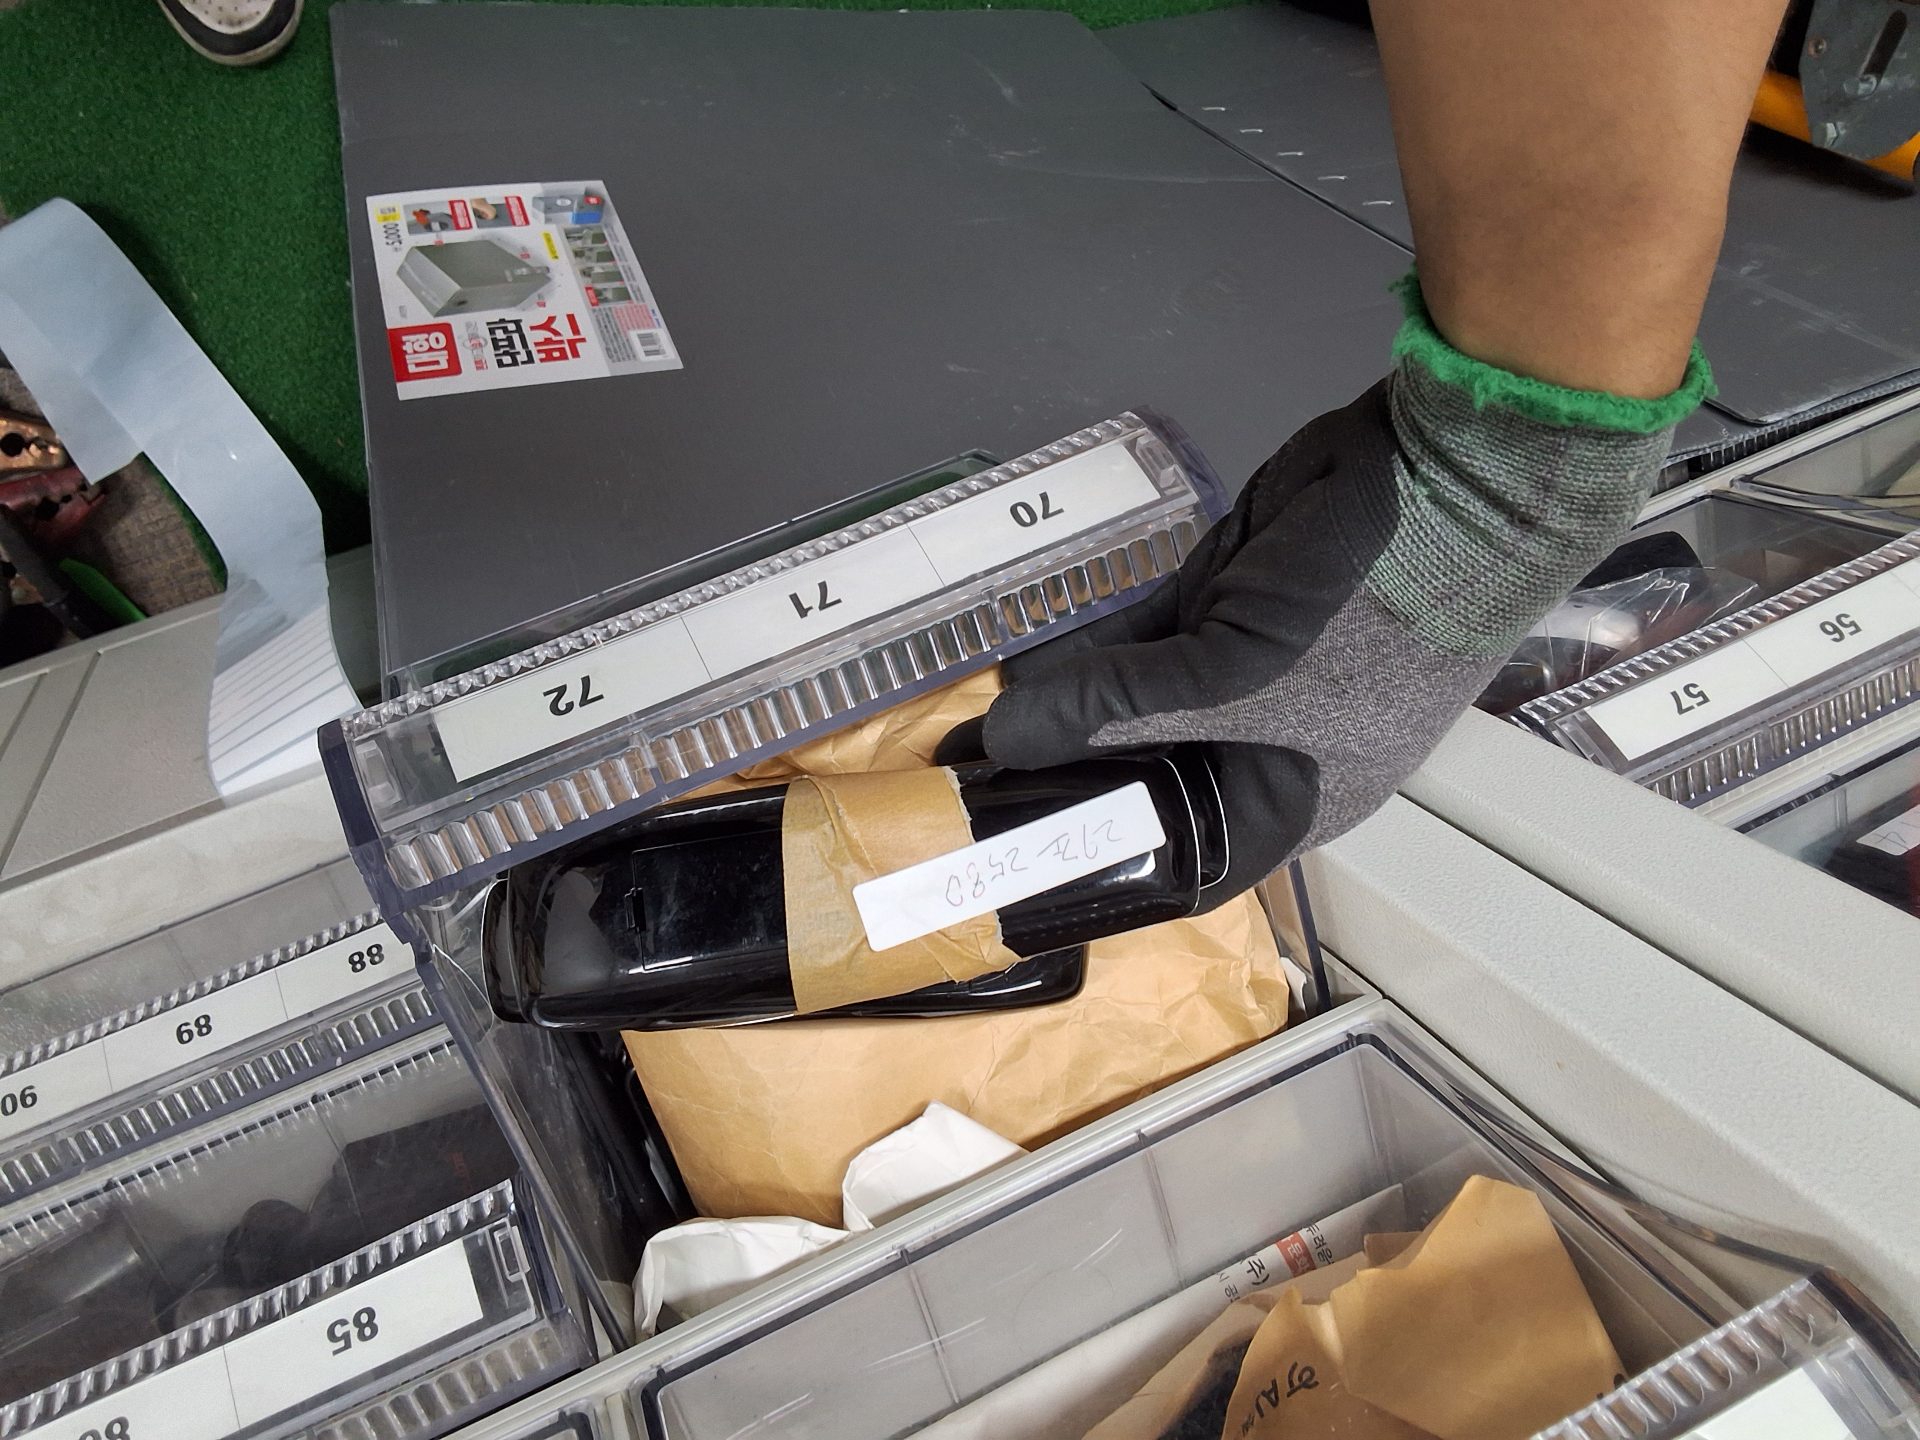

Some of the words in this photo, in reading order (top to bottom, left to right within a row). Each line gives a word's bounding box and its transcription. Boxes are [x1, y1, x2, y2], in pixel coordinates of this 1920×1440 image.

[402, 331, 448, 374] 대형
[487, 318, 536, 369] 단프라
[529, 313, 587, 363] 박스
[1010, 492, 1064, 528] 70
[789, 581, 842, 619] 71
[1819, 613, 1862, 642] 56
[542, 674, 605, 717] 72
[1669, 682, 1710, 715] 57
[348, 943, 385, 974] 88
[176, 1014, 213, 1045] 89
[0, 1085, 38, 1117] 90
[326, 1306, 379, 1355] 85
